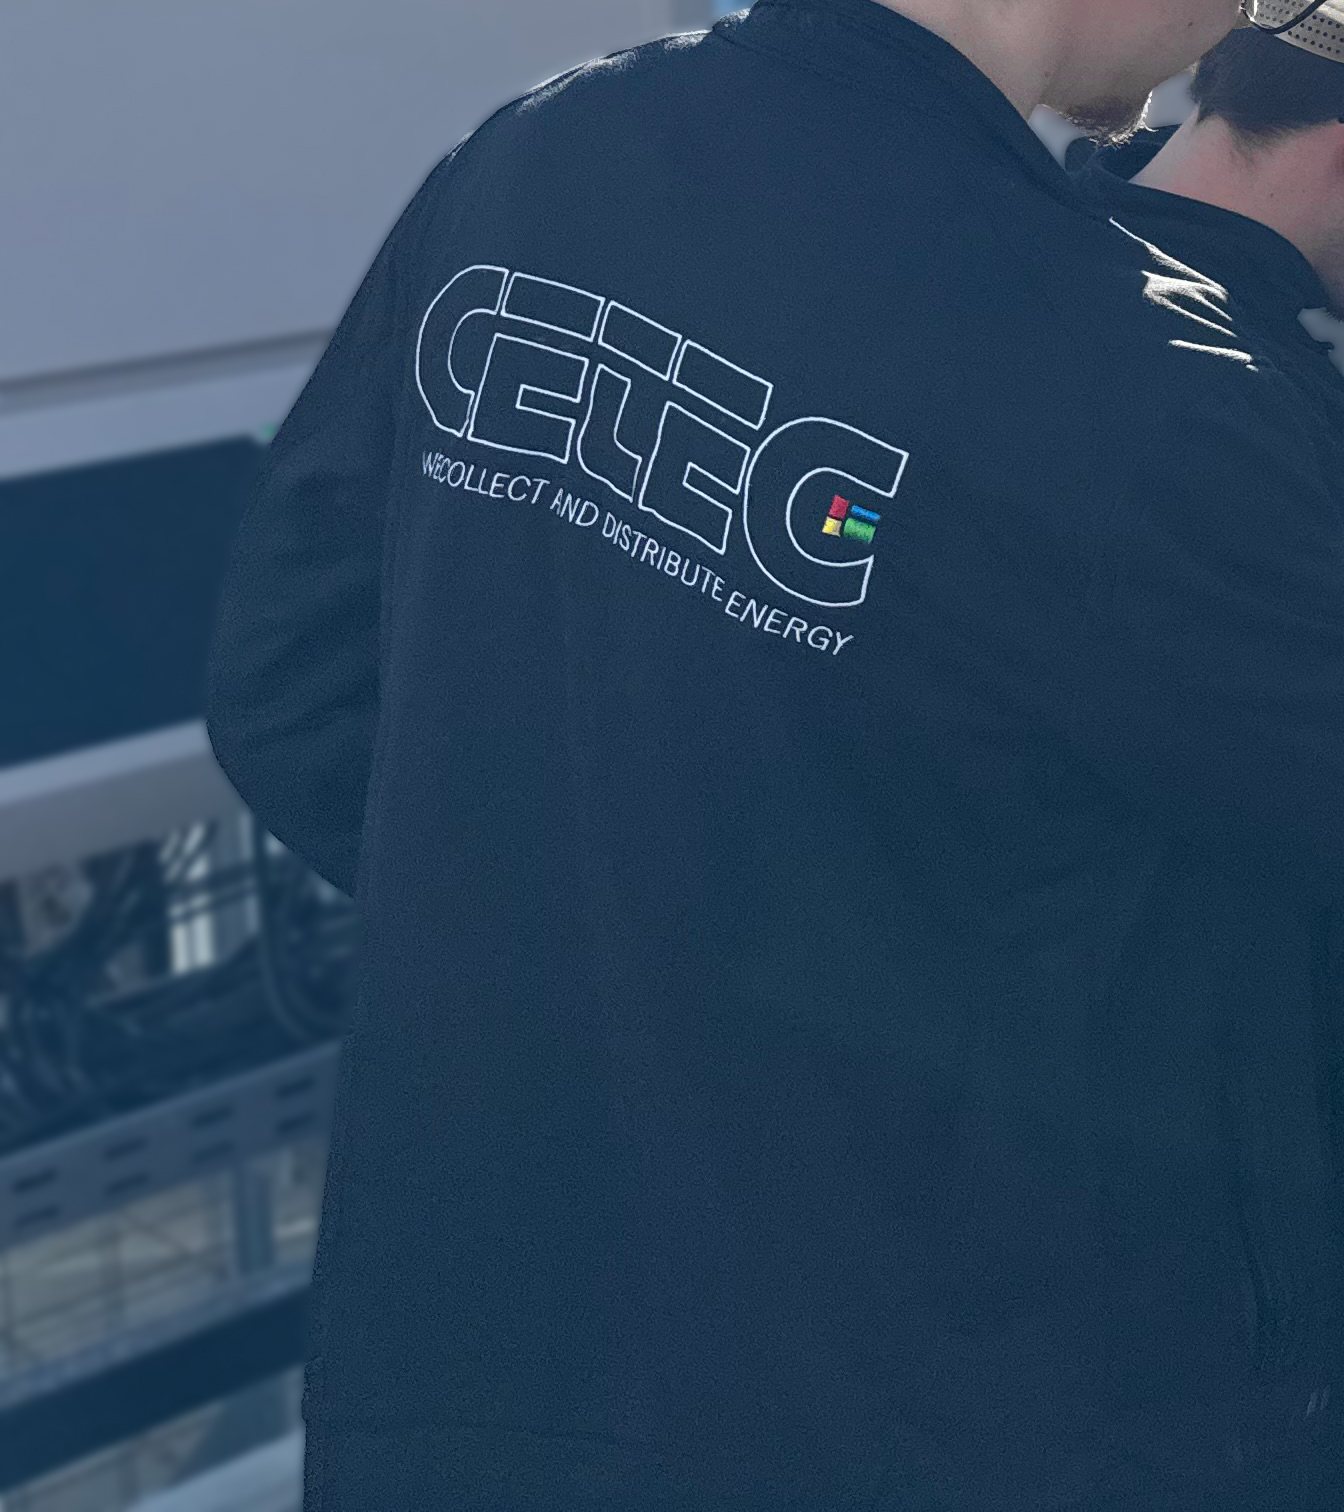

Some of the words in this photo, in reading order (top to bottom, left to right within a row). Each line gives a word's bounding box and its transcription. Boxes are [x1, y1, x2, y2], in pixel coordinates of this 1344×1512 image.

[550, 488, 600, 527] AND
[602, 511, 726, 601] DISTRIBUTE
[724, 591, 854, 656] ENERGY
